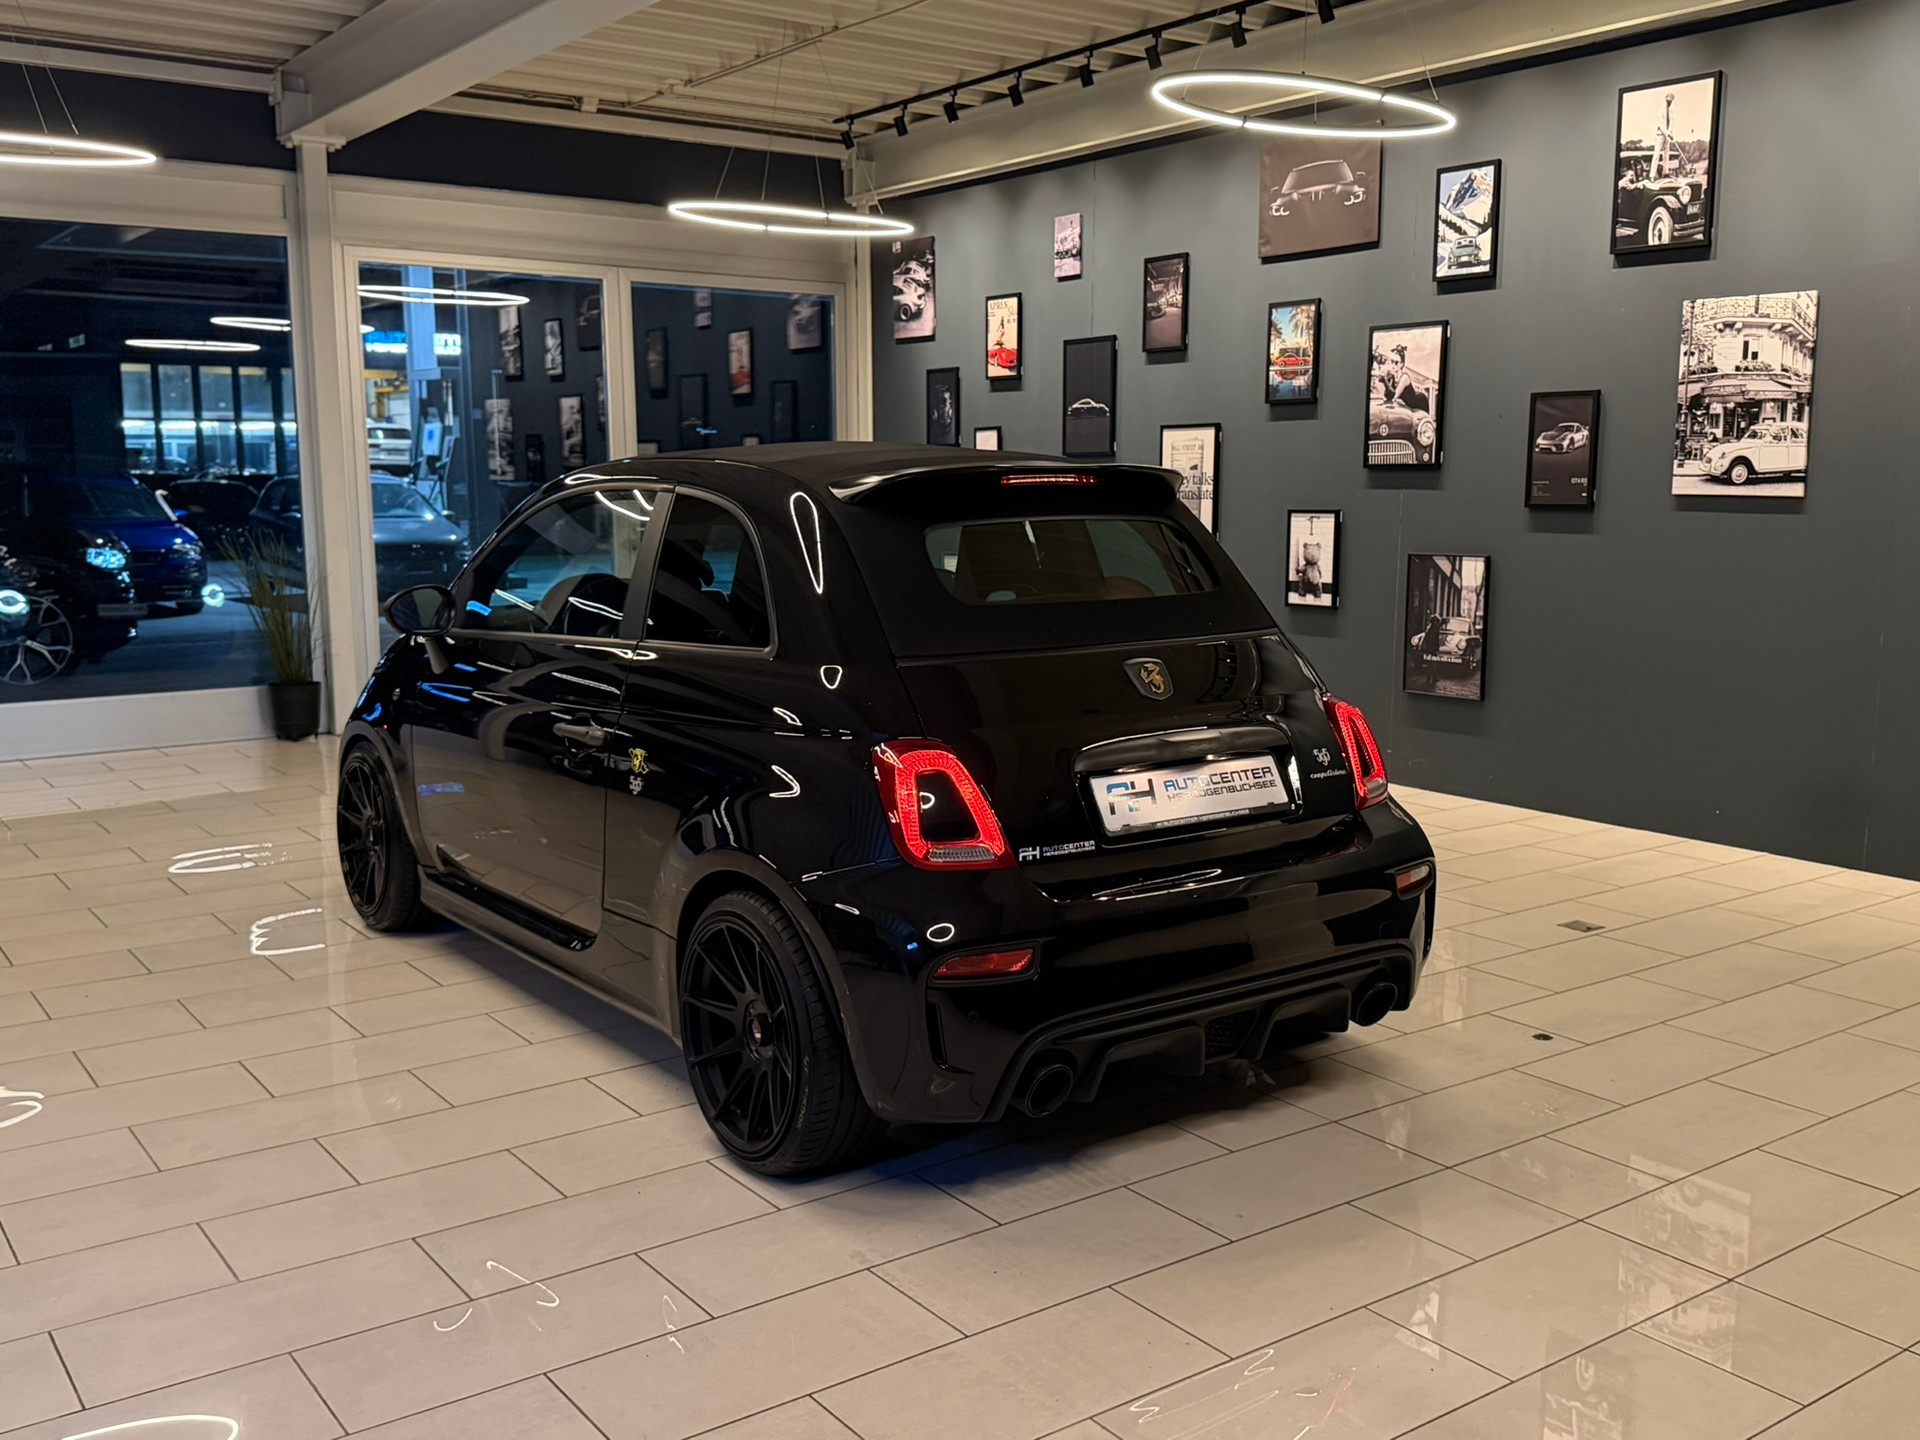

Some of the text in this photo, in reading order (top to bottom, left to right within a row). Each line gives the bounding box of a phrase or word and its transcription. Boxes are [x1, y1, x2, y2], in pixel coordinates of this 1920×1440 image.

[1178, 486, 1214, 500] ranslate
[1163, 766, 1274, 792] AUTOCENTER
[1167, 779, 1278, 802] HERZOGENBUCHSEE
[1042, 840, 1096, 853] AUTOCENTER
